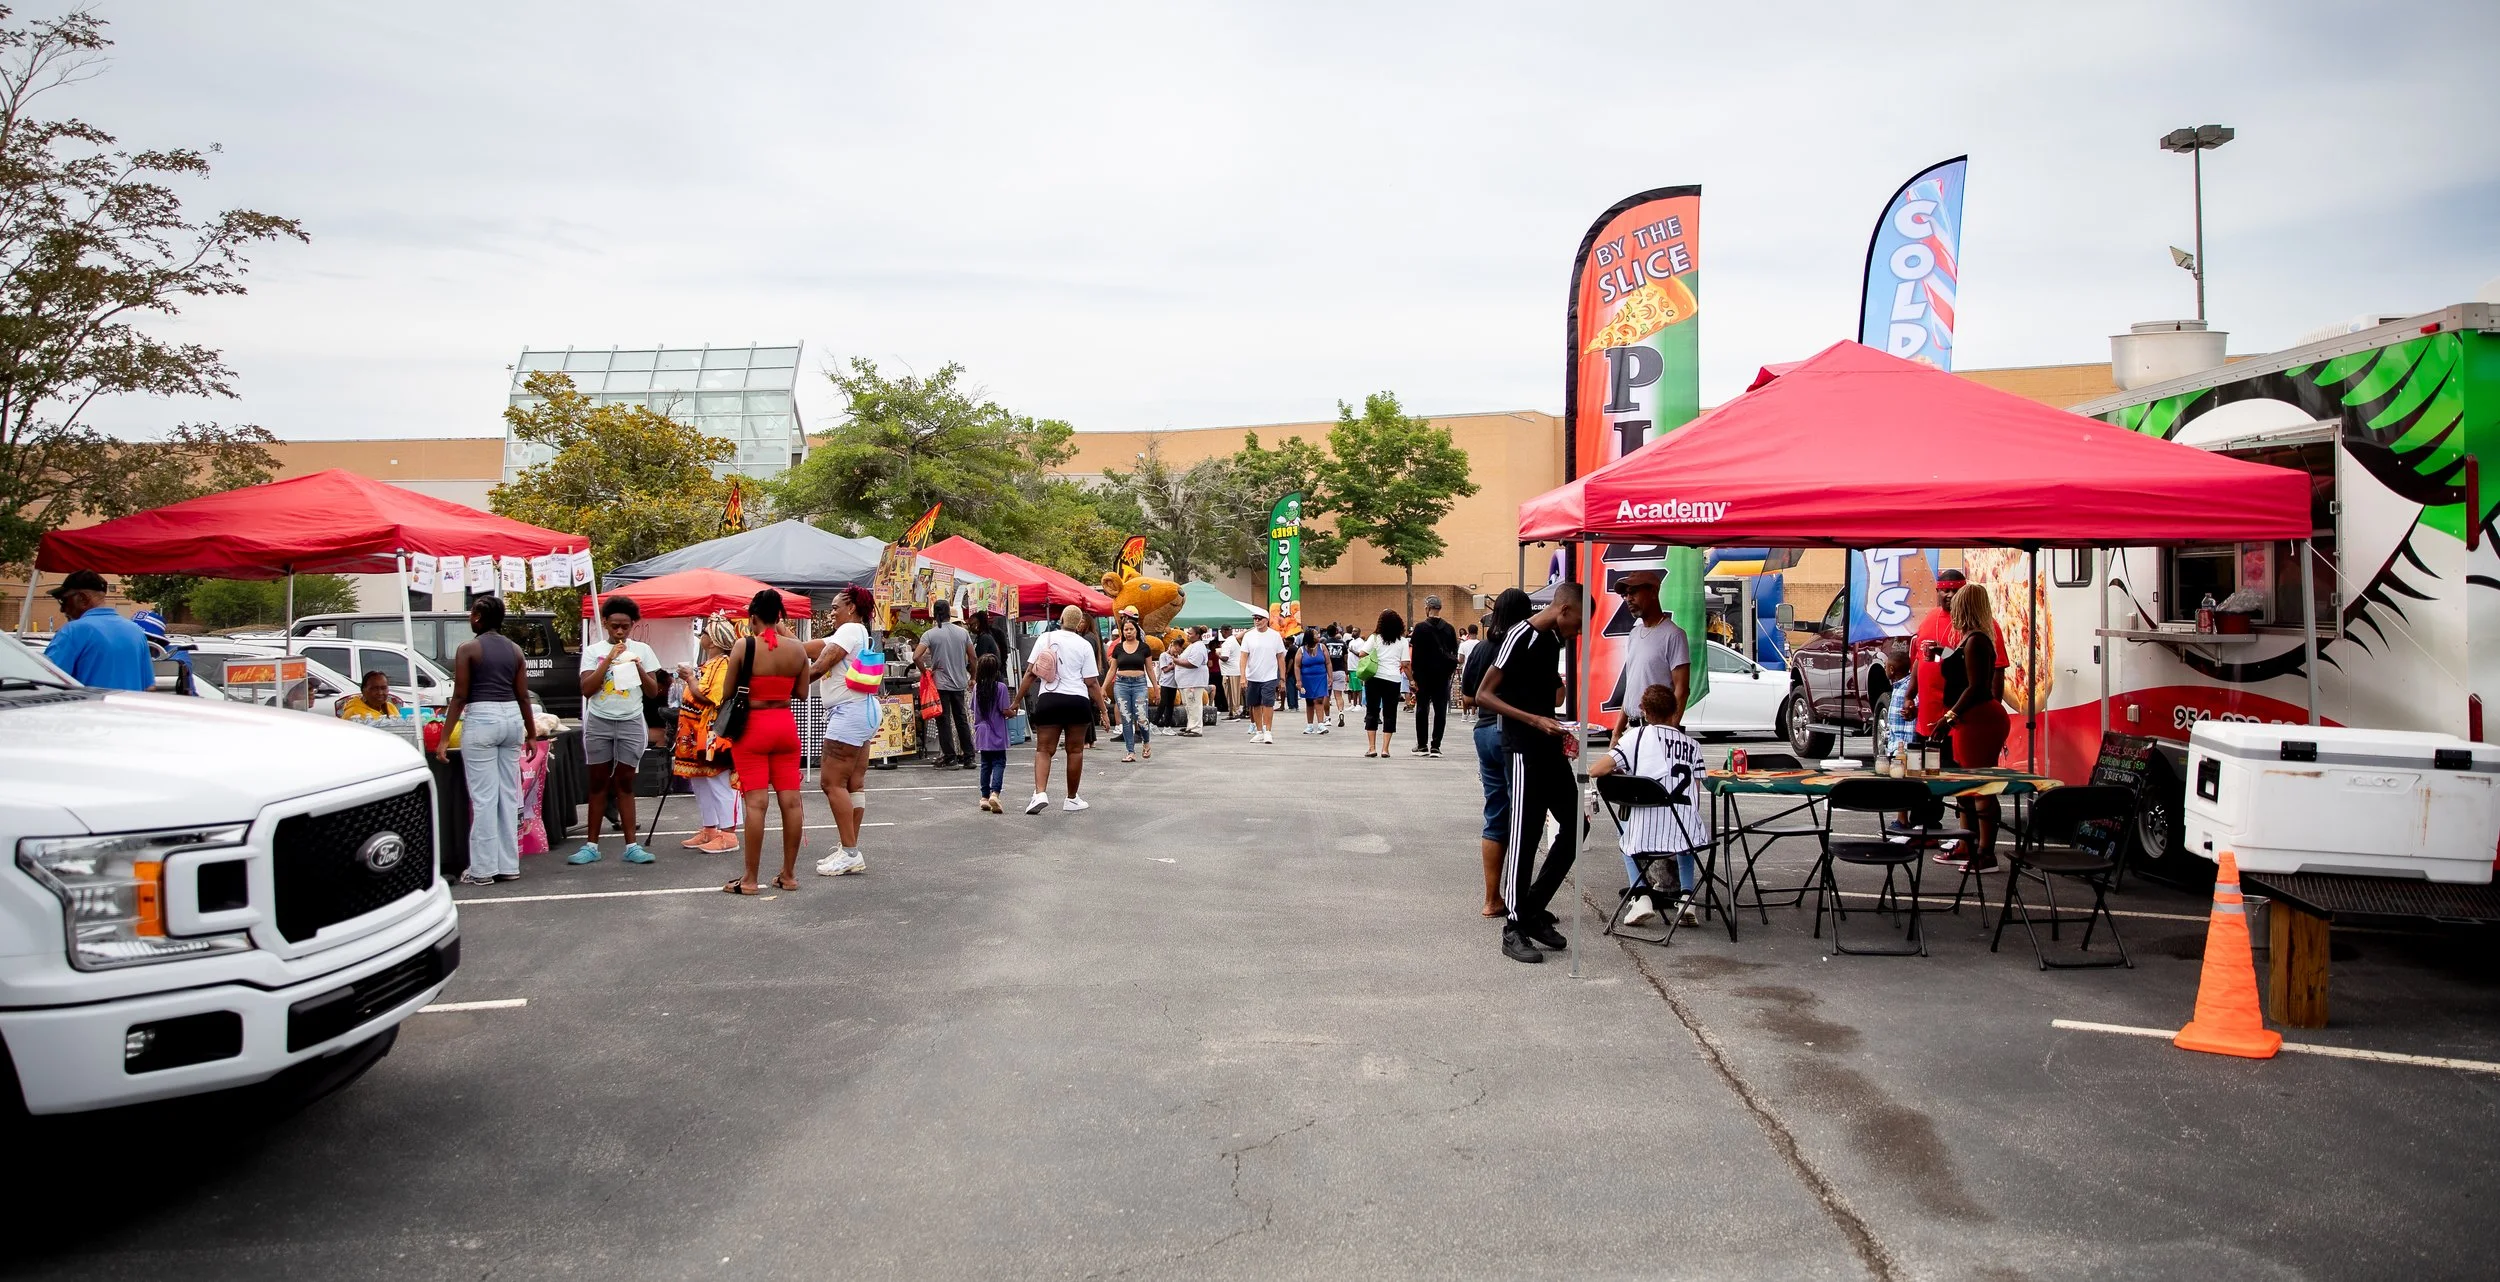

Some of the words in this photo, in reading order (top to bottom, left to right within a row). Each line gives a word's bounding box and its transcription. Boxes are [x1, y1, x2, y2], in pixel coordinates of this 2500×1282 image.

[1595, 236, 1625, 268] BY
[1632, 215, 1682, 249] THE
[1599, 242, 1692, 304] SLICE
[1886, 199, 1939, 360] COLD
[1616, 499, 1728, 520] Academy
[539, 659, 552, 668] BBQ
[1665, 738, 1695, 764] YORK
[378, 843, 399, 865] Ford
